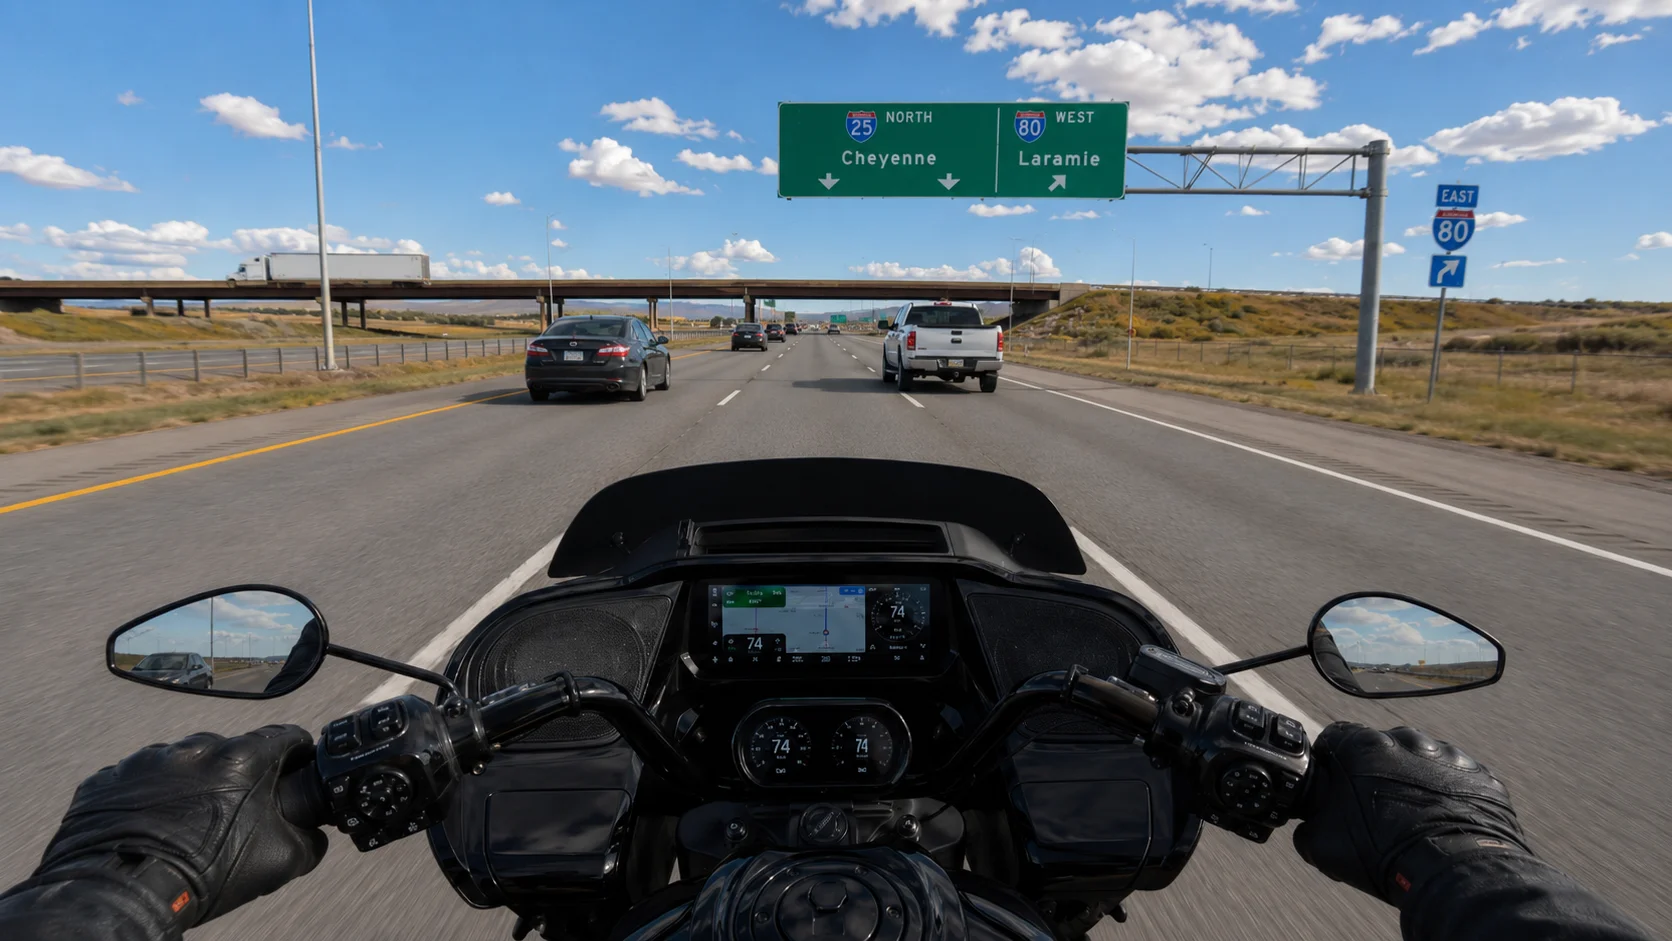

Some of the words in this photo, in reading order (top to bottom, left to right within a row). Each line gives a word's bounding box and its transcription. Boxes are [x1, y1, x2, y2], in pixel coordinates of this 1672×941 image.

[851, 119, 873, 136] 25
[886, 111, 933, 123] NORTH
[1018, 119, 1041, 136] 80
[1056, 111, 1095, 123] WEST
[842, 150, 936, 168] Cheyenne
[1019, 150, 1100, 166] Laramie
[1442, 189, 1475, 203] EAST
[1438, 220, 1469, 242] 80
[890, 605, 905, 618] 74
[747, 636, 763, 650] 74
[772, 739, 790, 754] 74
[855, 738, 868, 753] 74
